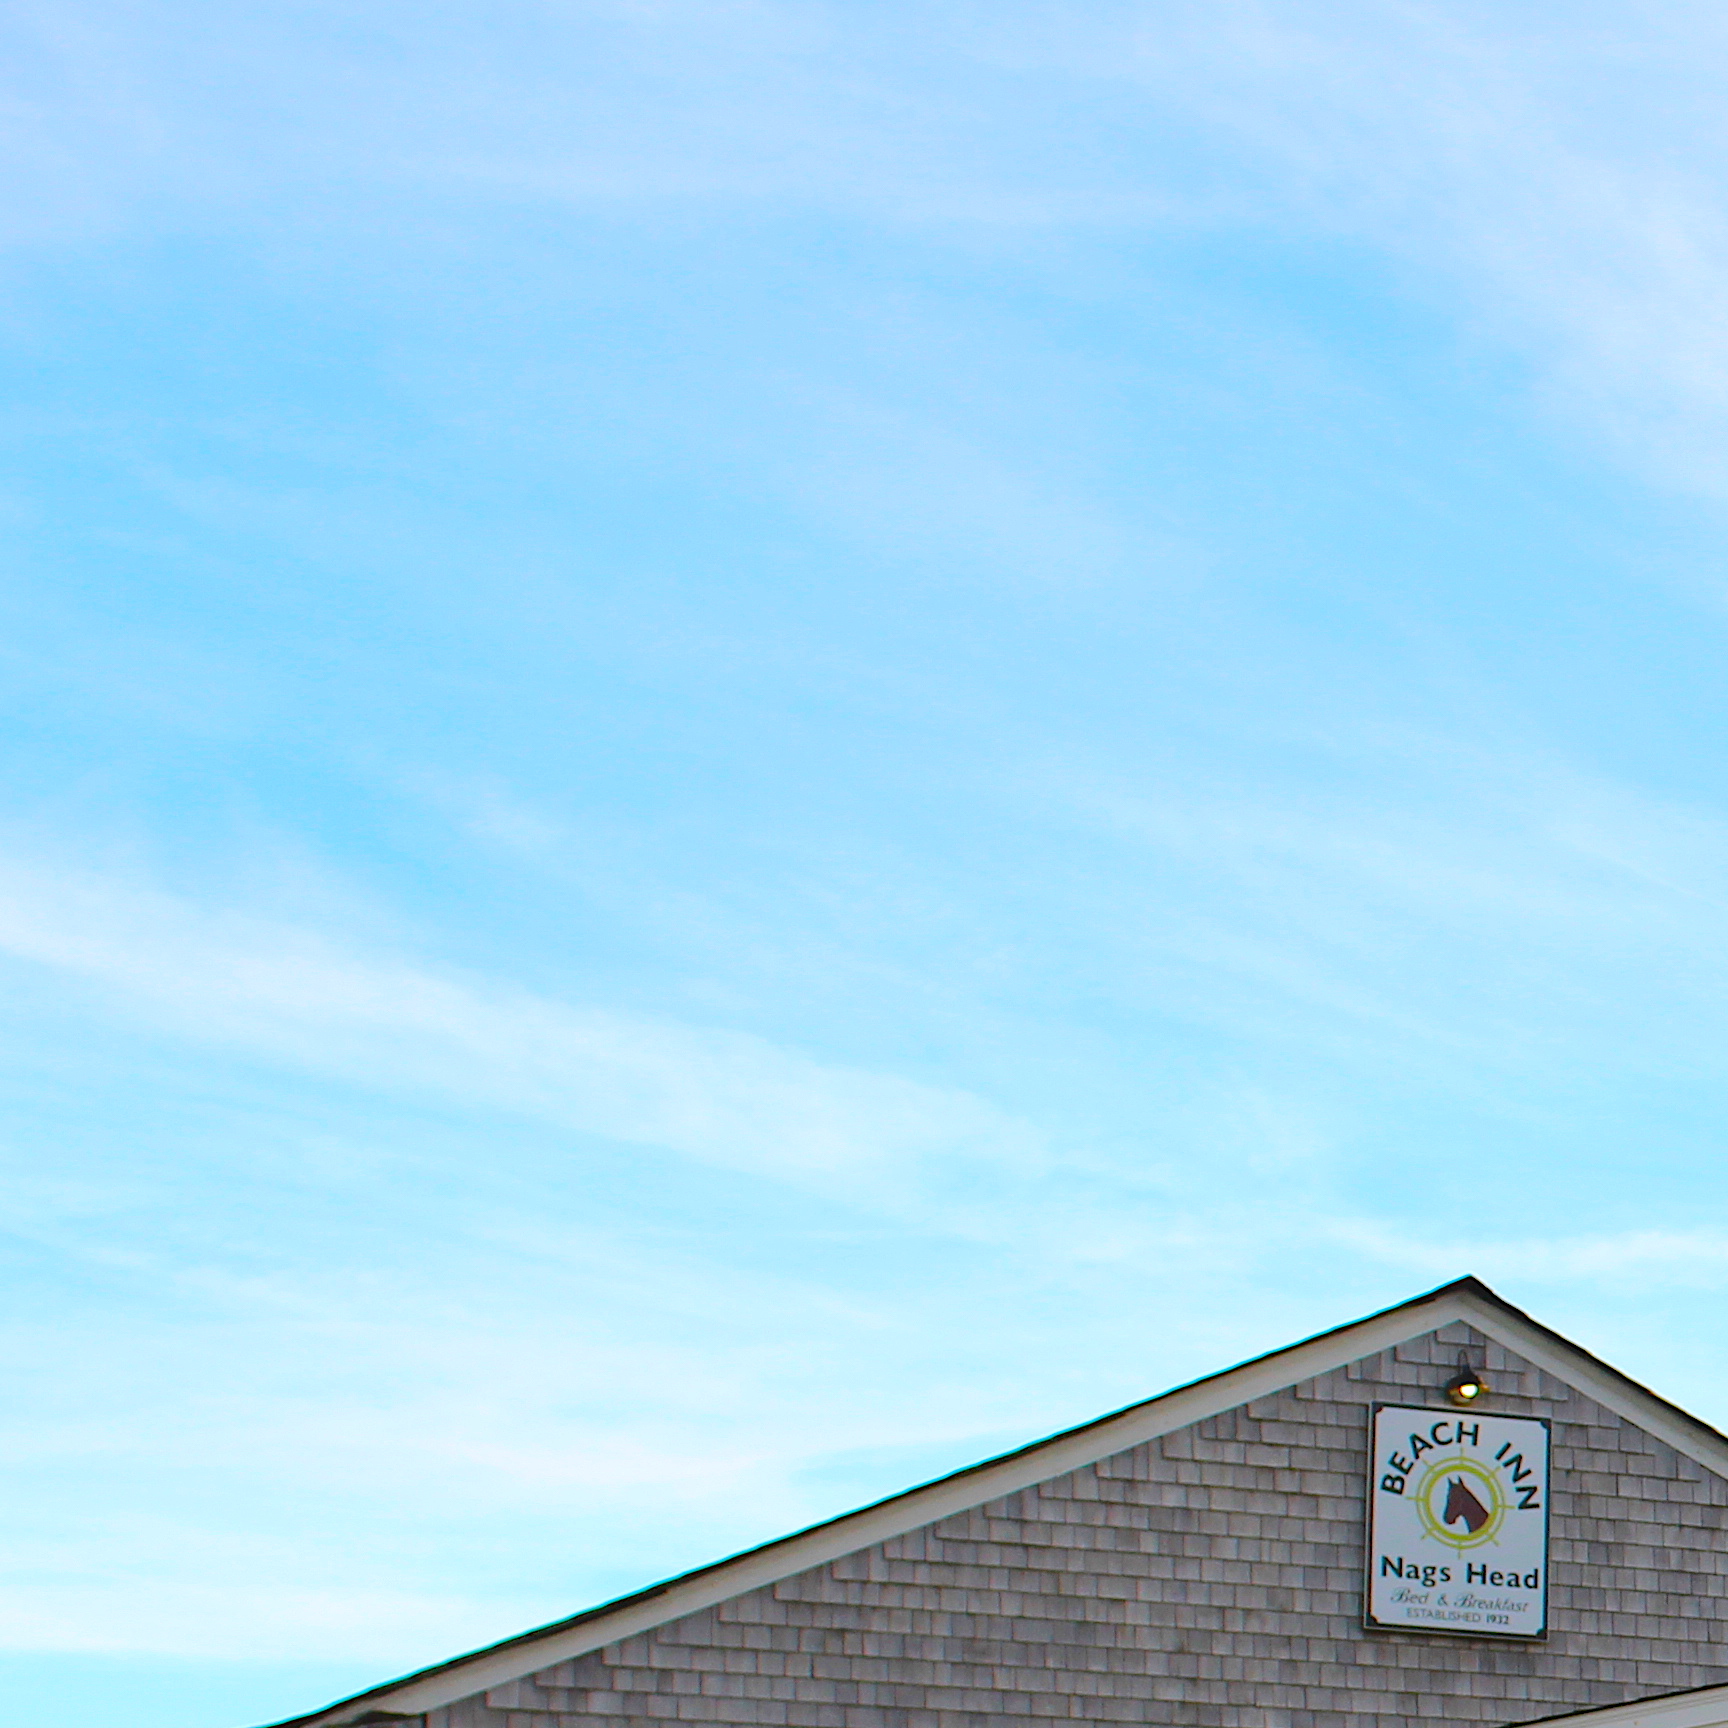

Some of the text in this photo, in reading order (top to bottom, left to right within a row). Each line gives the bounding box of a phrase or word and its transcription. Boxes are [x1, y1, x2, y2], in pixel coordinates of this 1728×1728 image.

[1381, 1421, 1541, 1510] BEACH INN
[1381, 1556, 1538, 1589] Nags Head
[1390, 1587, 1530, 1612] Bed & Breakfast
[1406, 1608, 1509, 1625] ESTABLISHED 1932
